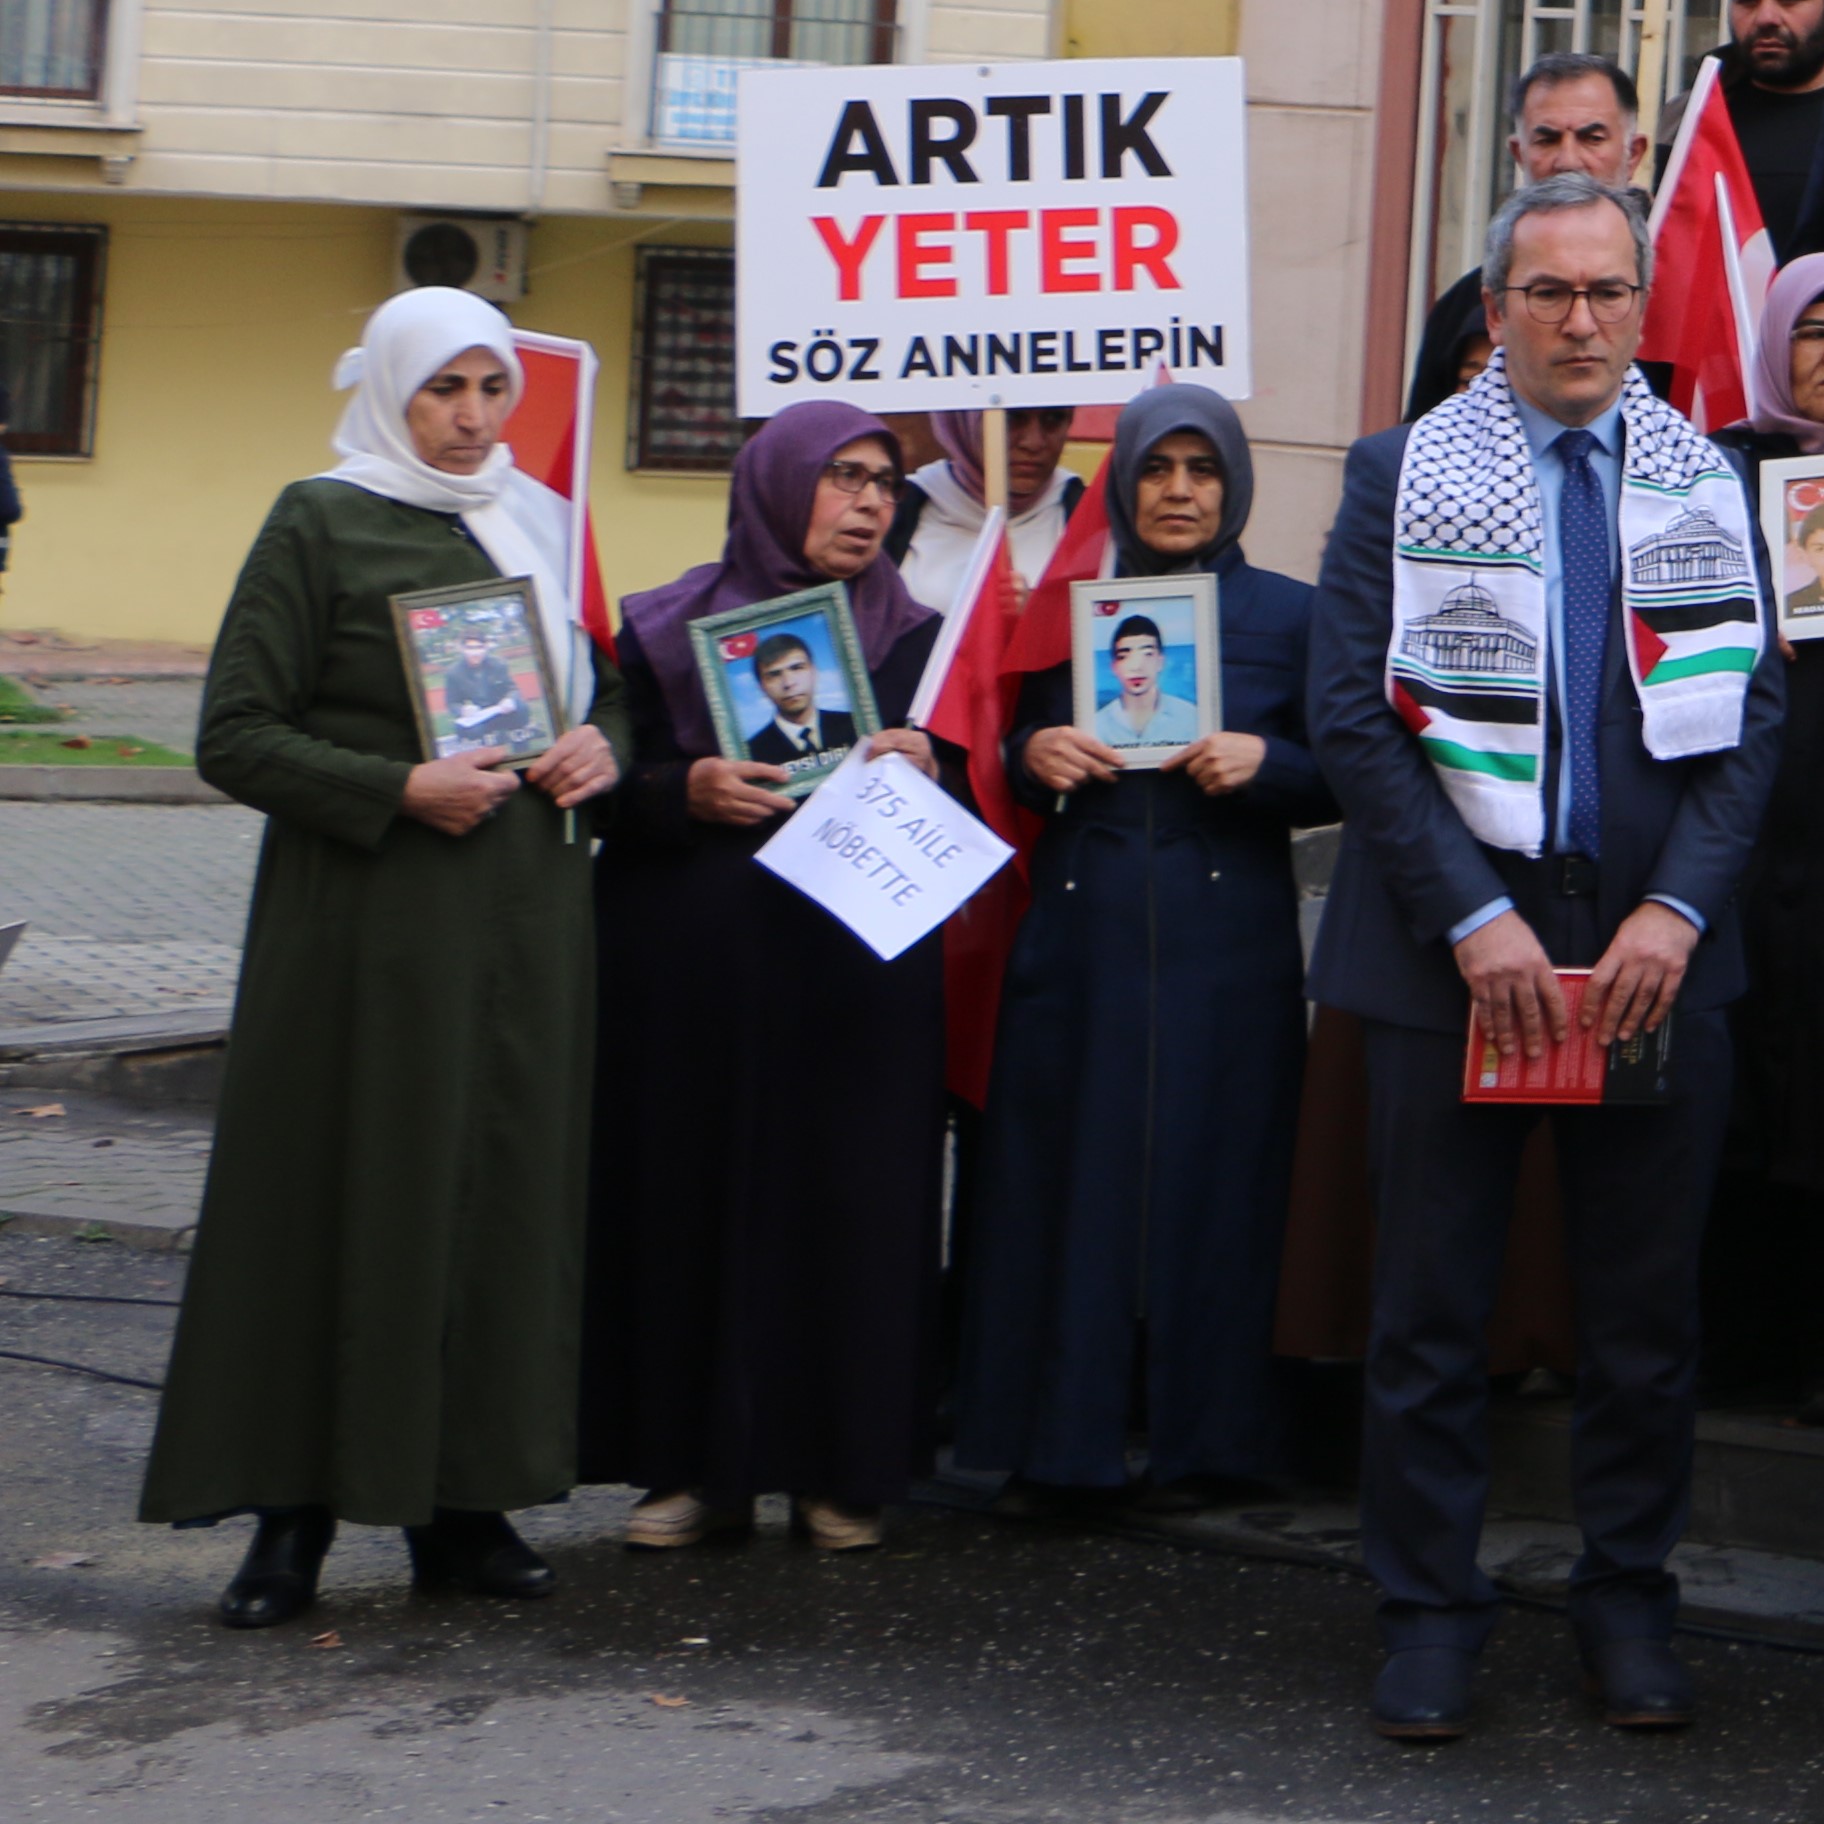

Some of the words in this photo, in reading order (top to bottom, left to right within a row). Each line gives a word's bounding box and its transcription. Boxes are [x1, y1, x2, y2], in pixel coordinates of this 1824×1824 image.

[816, 90, 1174, 189] ARTIK
[810, 204, 1183, 302] YETER
[768, 328, 881, 385] SÖZ
[899, 315, 1225, 380] ANNELERİN
[854, 776, 910, 819] 375
[810, 816, 924, 908] NÖBETTE
